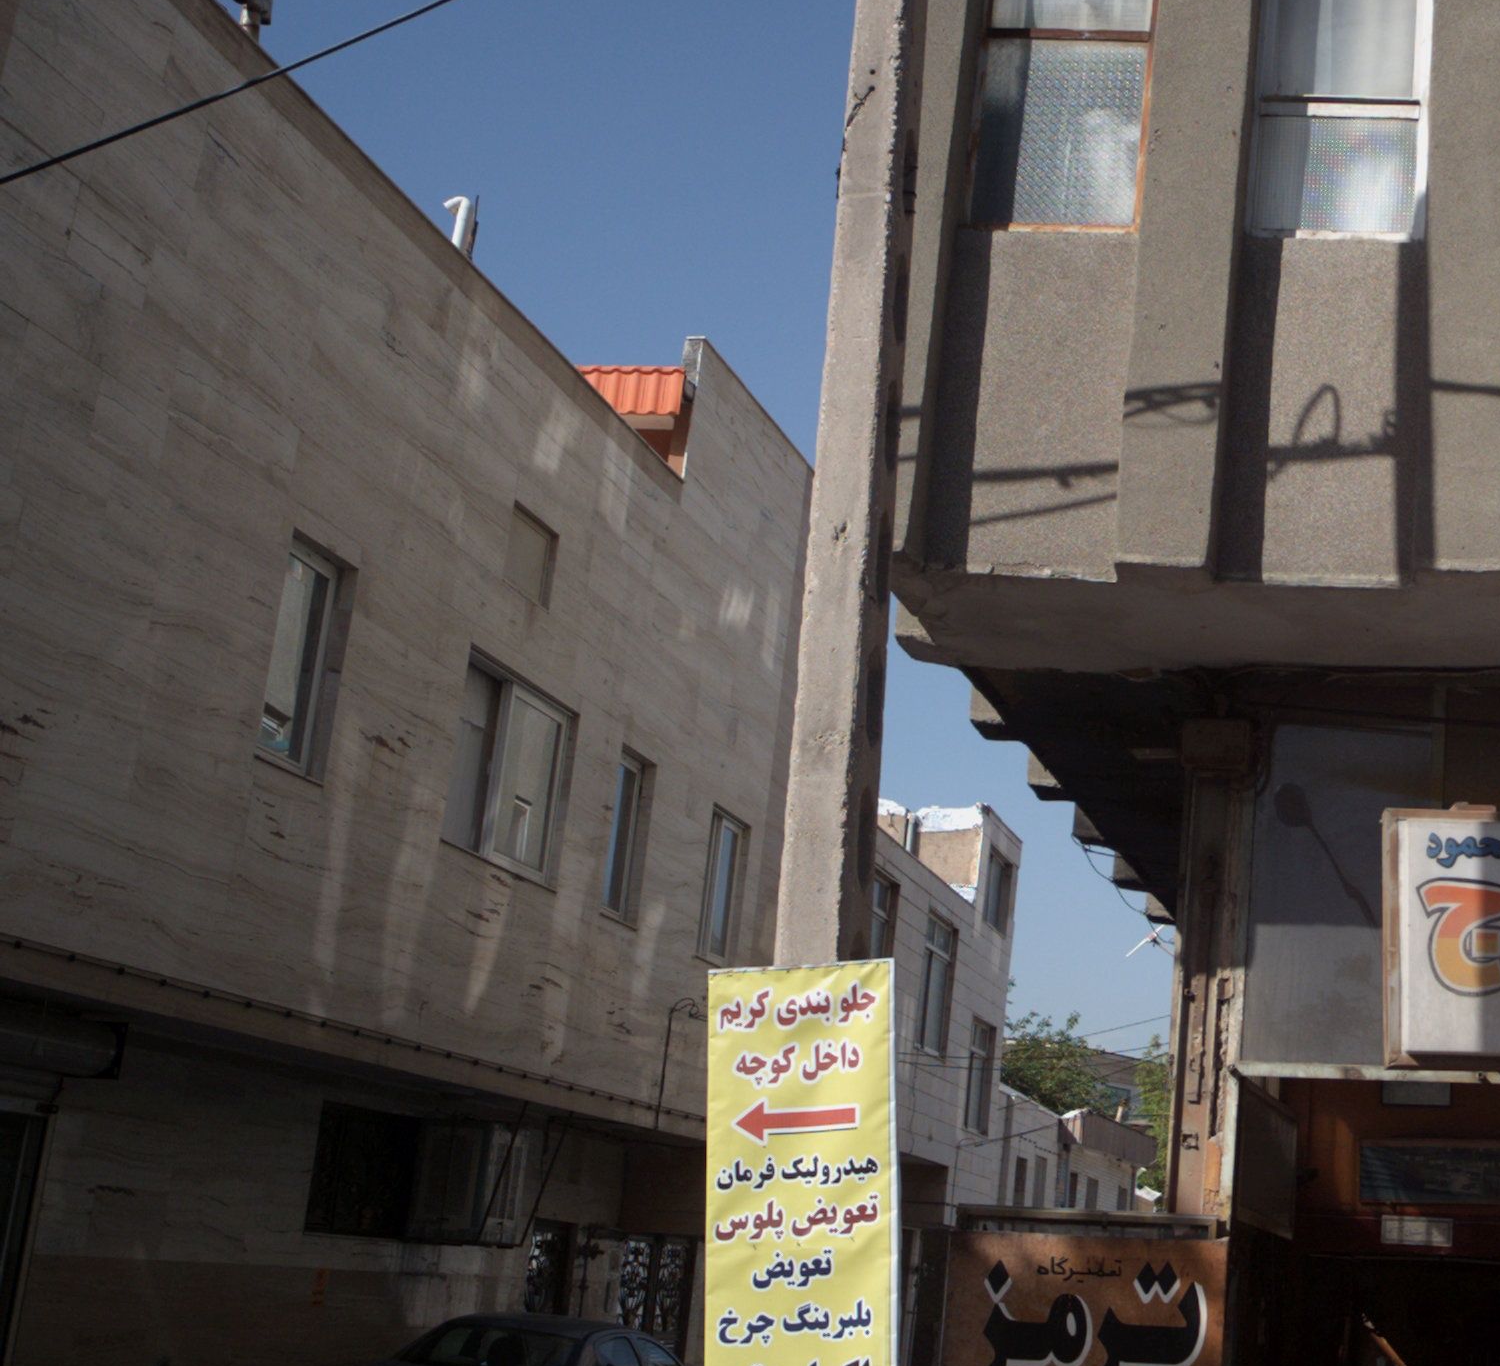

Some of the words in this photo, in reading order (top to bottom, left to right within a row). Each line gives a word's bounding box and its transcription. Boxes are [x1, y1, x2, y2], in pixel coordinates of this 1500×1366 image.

[720, 991, 769, 1029] کریم
[736, 1046, 796, 1084] کوچه
[803, 1043, 859, 1080] داخل
[717, 1157, 775, 1189] فرمان
[782, 1156, 878, 1184] هیدرولیک
[715, 1201, 783, 1240] پلوس
[792, 1195, 878, 1236] تعویض
[753, 1250, 832, 1288] تعویض
[719, 1310, 774, 1343] چرخ
[783, 1300, 871, 1337] بلبرینگ
